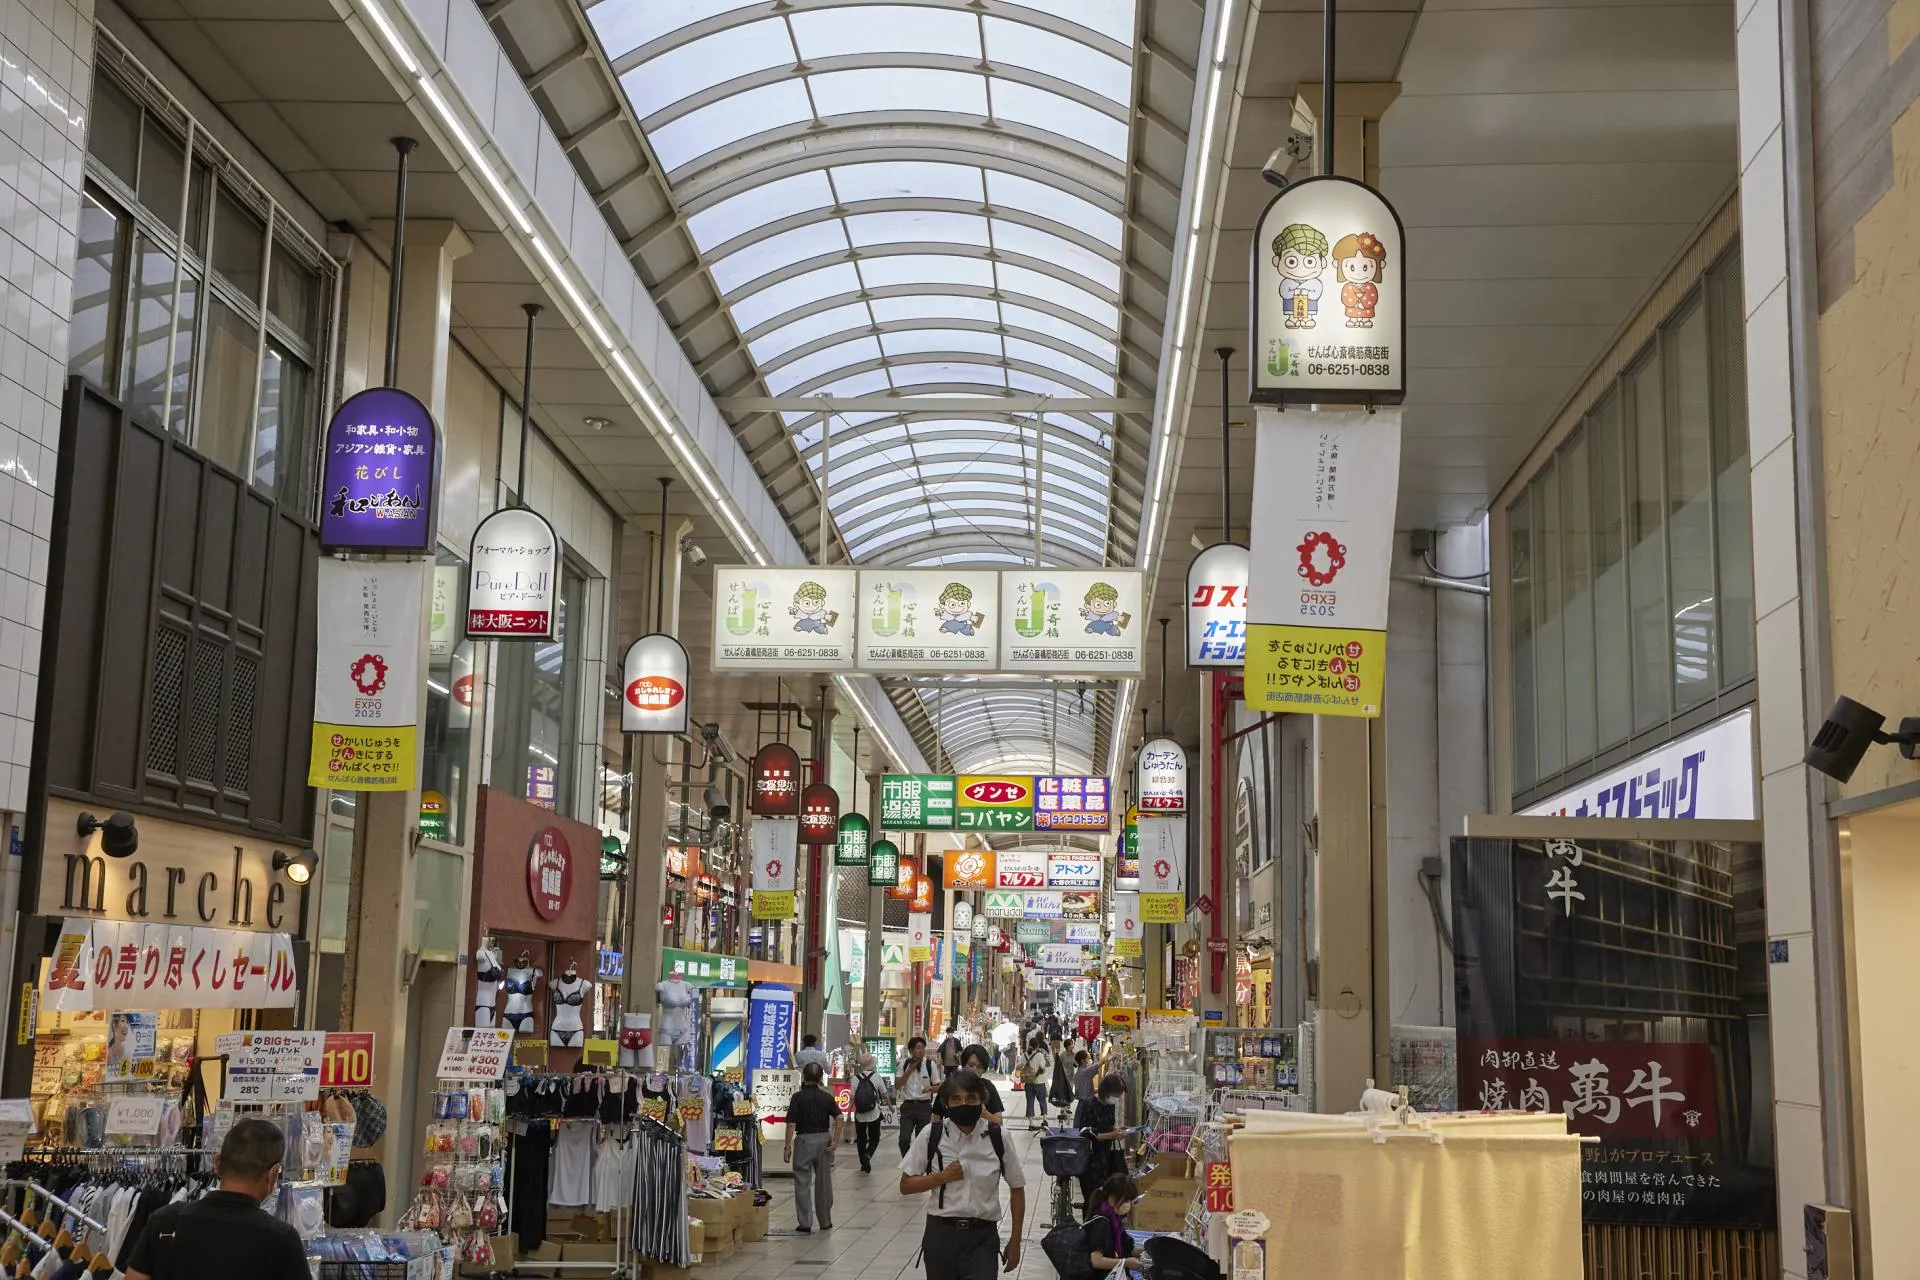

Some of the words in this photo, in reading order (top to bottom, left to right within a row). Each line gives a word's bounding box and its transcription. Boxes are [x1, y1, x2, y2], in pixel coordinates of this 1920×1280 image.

[1307, 346, 1389, 360] せんば心斎橋筋商店街
[1308, 363, 1390, 376] 06-6251-0838
[345, 424, 419, 436] 和家具・和小物
[335, 443, 425, 455] アジアン雑貨・家具
[354, 464, 403, 480] 花びし
[476, 545, 551, 555] フォーマル・ショップ
[1203, 620, 1247, 638] オーエ
[784, 648, 839, 657] 06-6251-0838
[930, 649, 985, 659] 06-6251-0838
[1075, 650, 1134, 660] 06-6251-0838
[355, 701, 382, 709] EXPO
[354, 709, 382, 718] 2025
[331, 734, 400, 747] せかいじゅうを
[332, 748, 393, 760] げんきにする
[1146, 752, 1179, 760] カーテン
[1143, 761, 1183, 770] じゅうたん
[1038, 778, 1105, 793] 化粧品
[973, 786, 1019, 798] グンゼ
[1038, 795, 1105, 810] 医薬品
[1143, 798, 1182, 808] マルクラ
[960, 811, 1031, 827] コバヤシ
[1055, 864, 1094, 875] アドオン
[1000, 873, 1043, 886] マルクラ
[60, 846, 287, 929] marche
[48, 934, 296, 991] 夏の売り尽くしセール
[474, 1032, 496, 1040] スマホ
[471, 1040, 508, 1048] ストラップ
[253, 1047, 300, 1055] クールバンド
[471, 1055, 499, 1065] ¥300
[1480, 1049, 1560, 1070] 肉卸直送
[467, 1066, 497, 1075] ¥500
[1479, 1077, 1550, 1114] 焼肉
[1562, 1057, 1686, 1128] 萬牛
[117, 1107, 154, 1119] ¥1,000
[1581, 1169, 1721, 1189] 食肉問屋を営んできた
[1582, 1189, 1686, 1207] の肉屋の焼肉店
